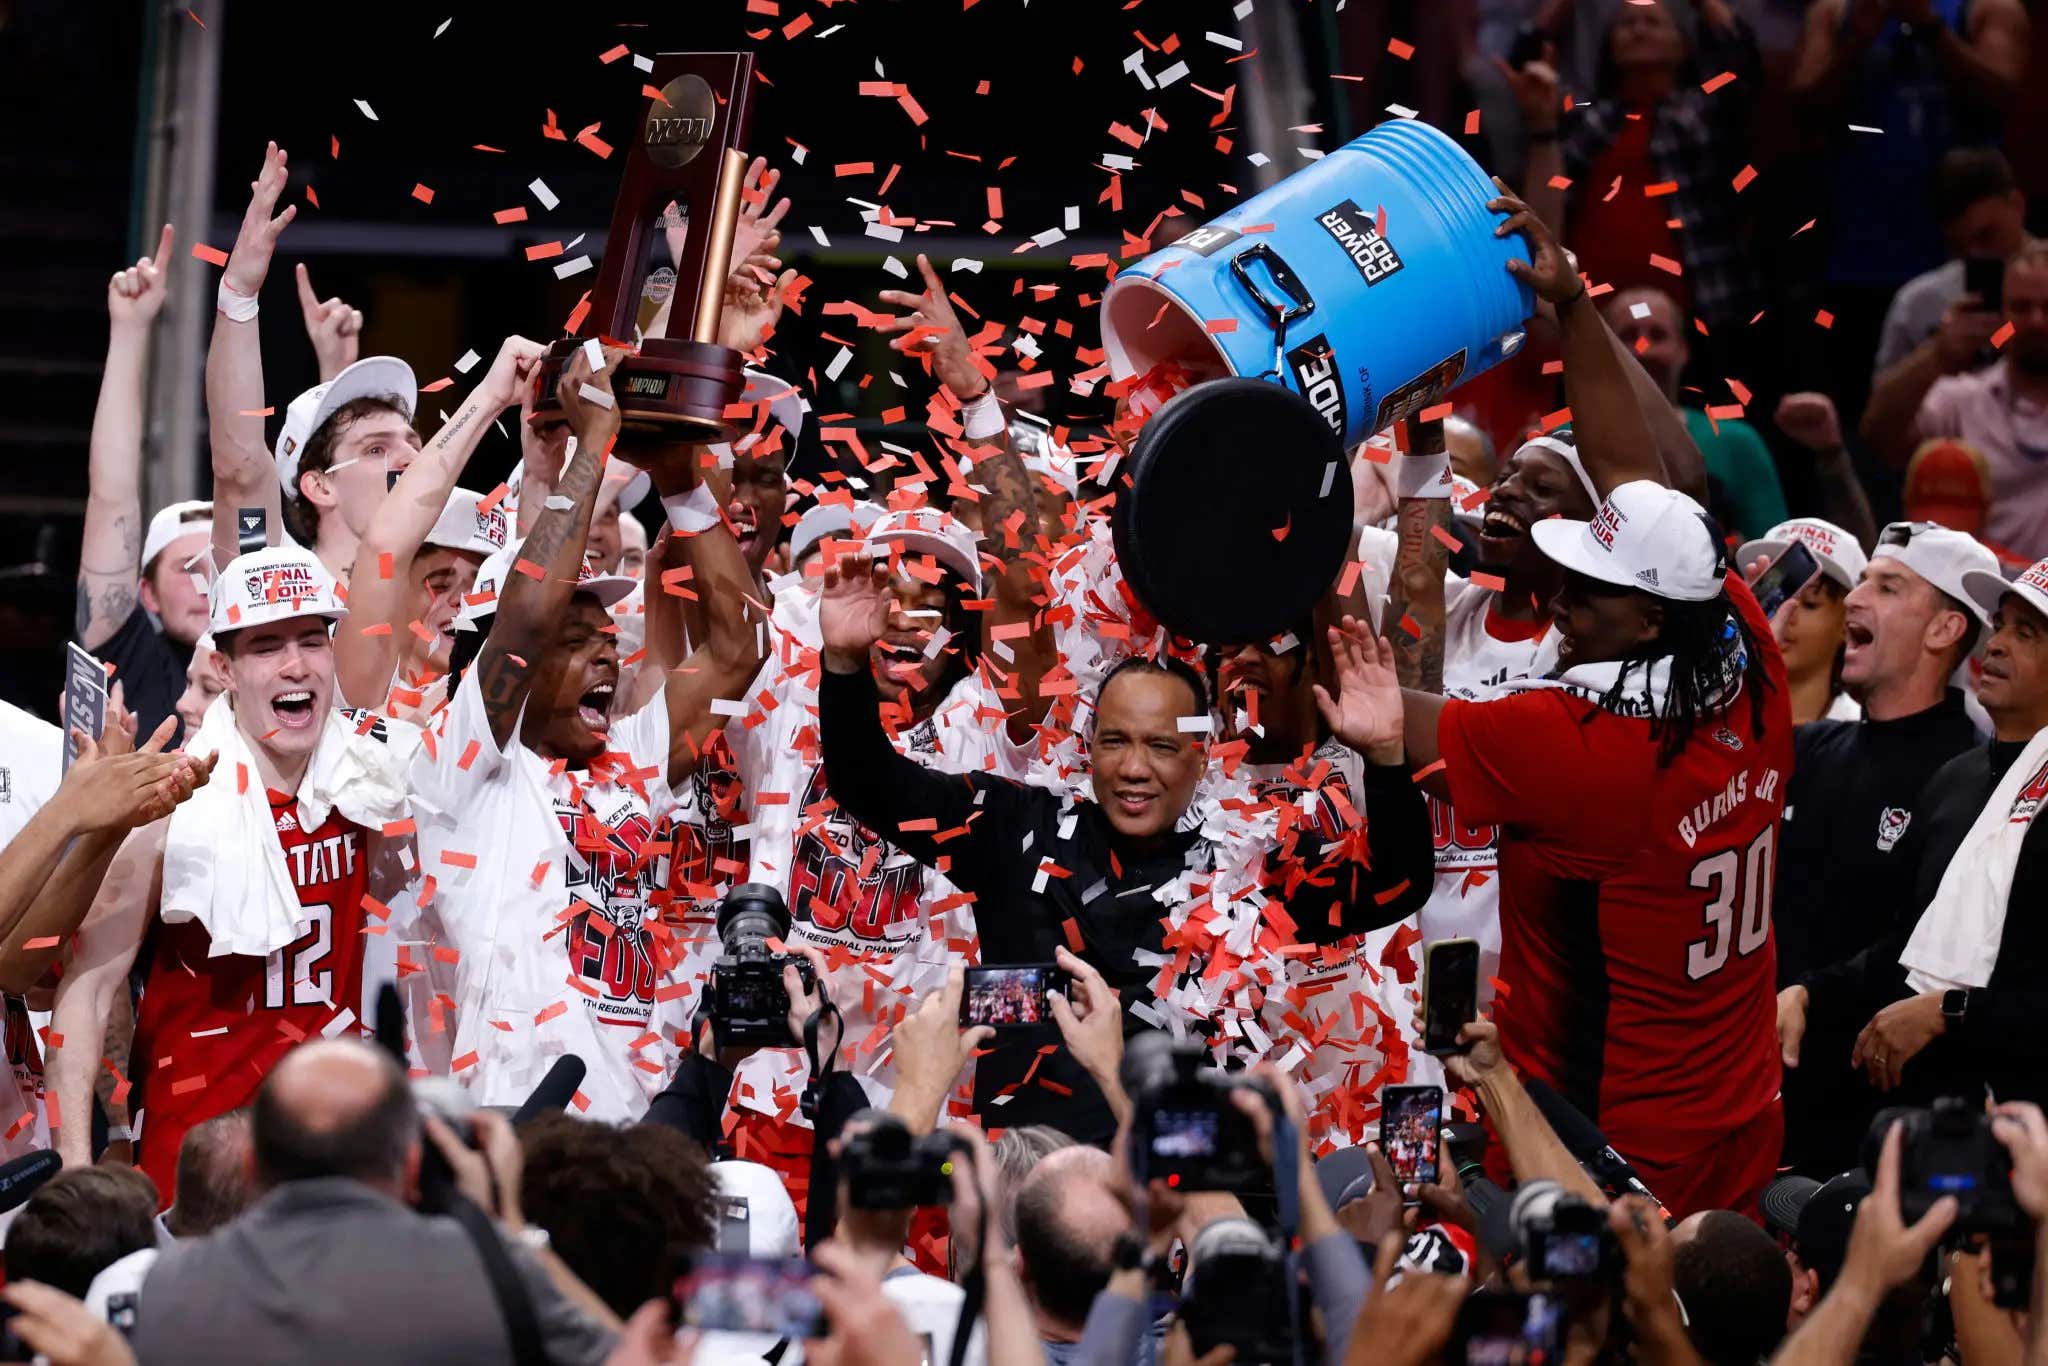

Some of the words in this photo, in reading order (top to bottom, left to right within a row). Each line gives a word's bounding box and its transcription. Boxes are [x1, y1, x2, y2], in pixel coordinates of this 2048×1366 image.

[648, 118, 711, 144] NCAA
[1321, 211, 1383, 282] POWER
[1363, 228, 1400, 274] ADE
[1592, 516, 1614, 549] OUR
[1601, 503, 1620, 532] NAL
[1678, 769, 1748, 849] BURNS
[284, 832, 358, 887] TATE
[1687, 822, 1774, 981] 30
[266, 904, 333, 1009] 12
[806, 931, 863, 952] REGIONAL
[598, 1003, 643, 1016] REGIONAL
